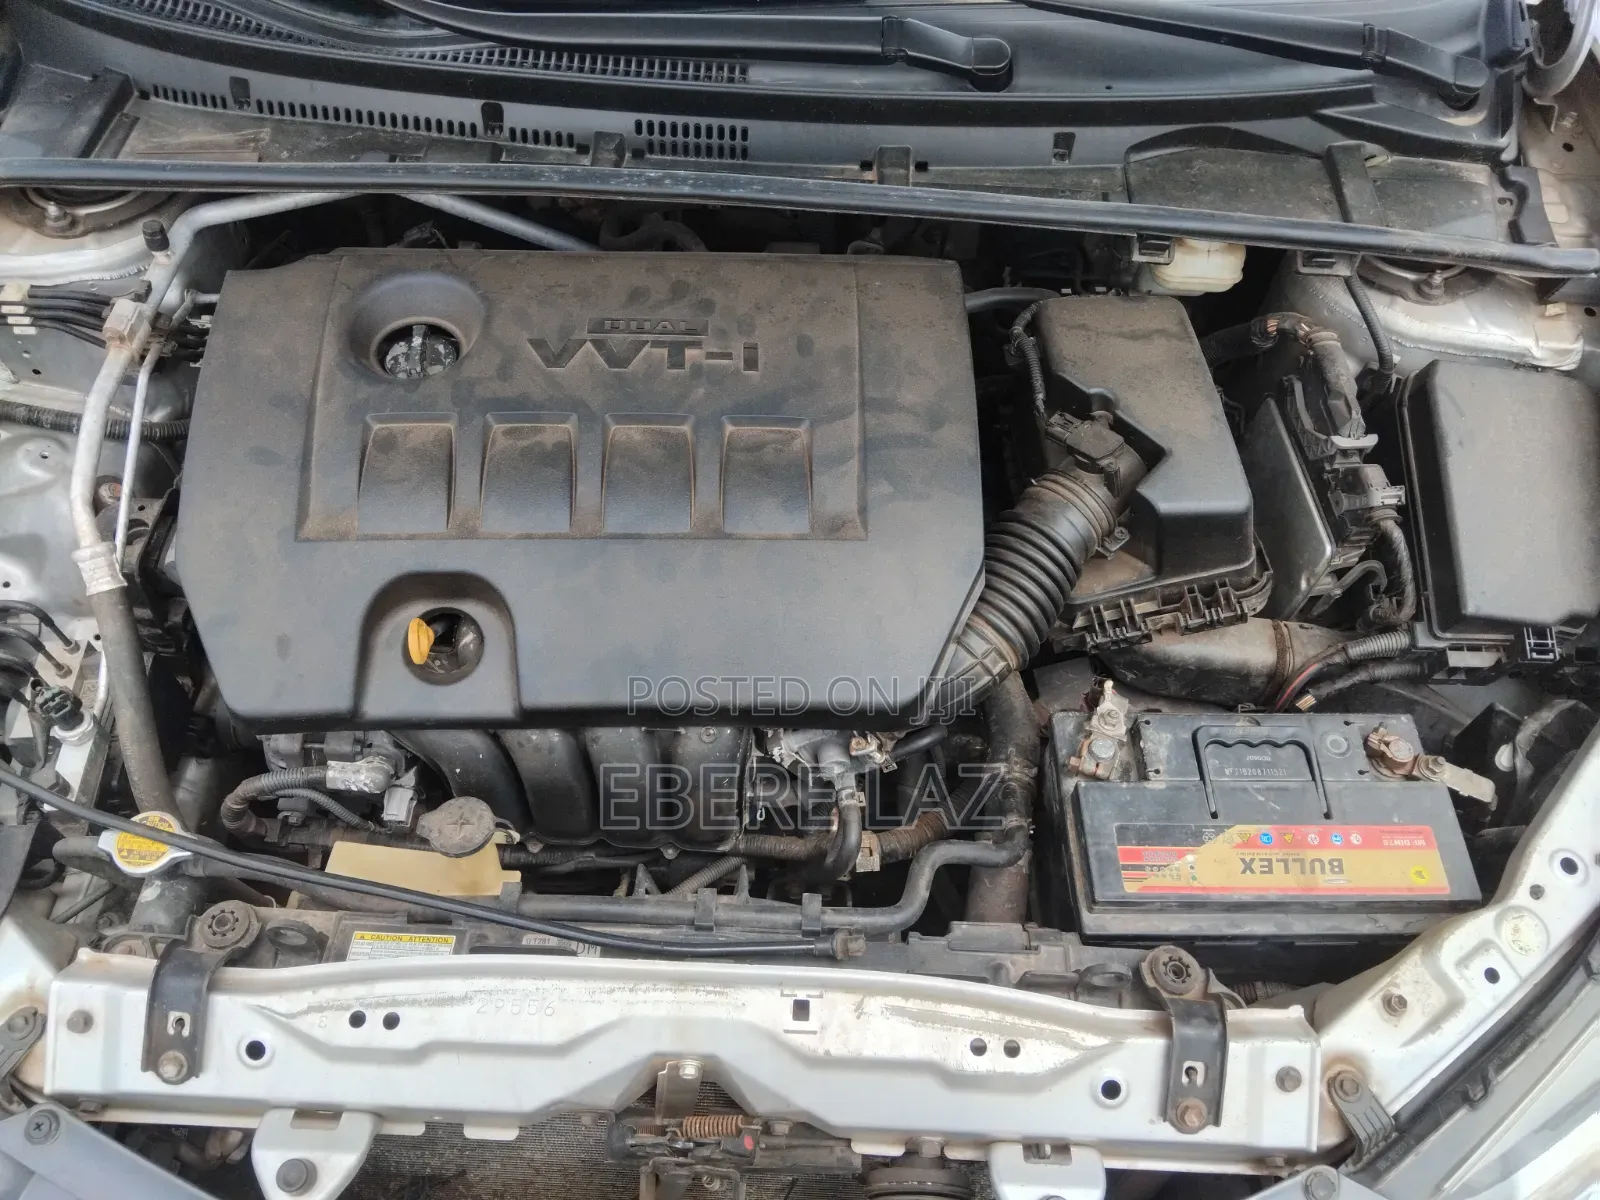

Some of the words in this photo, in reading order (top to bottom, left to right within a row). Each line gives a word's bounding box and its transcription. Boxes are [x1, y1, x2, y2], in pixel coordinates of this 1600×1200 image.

[604, 319, 697, 331] DUAL
[1239, 857, 1345, 875] BULLEX
[370, 934, 403, 942] CAUTION
[408, 935, 449, 943] ATTENTION
[475, 996, 556, 1017] 29556
